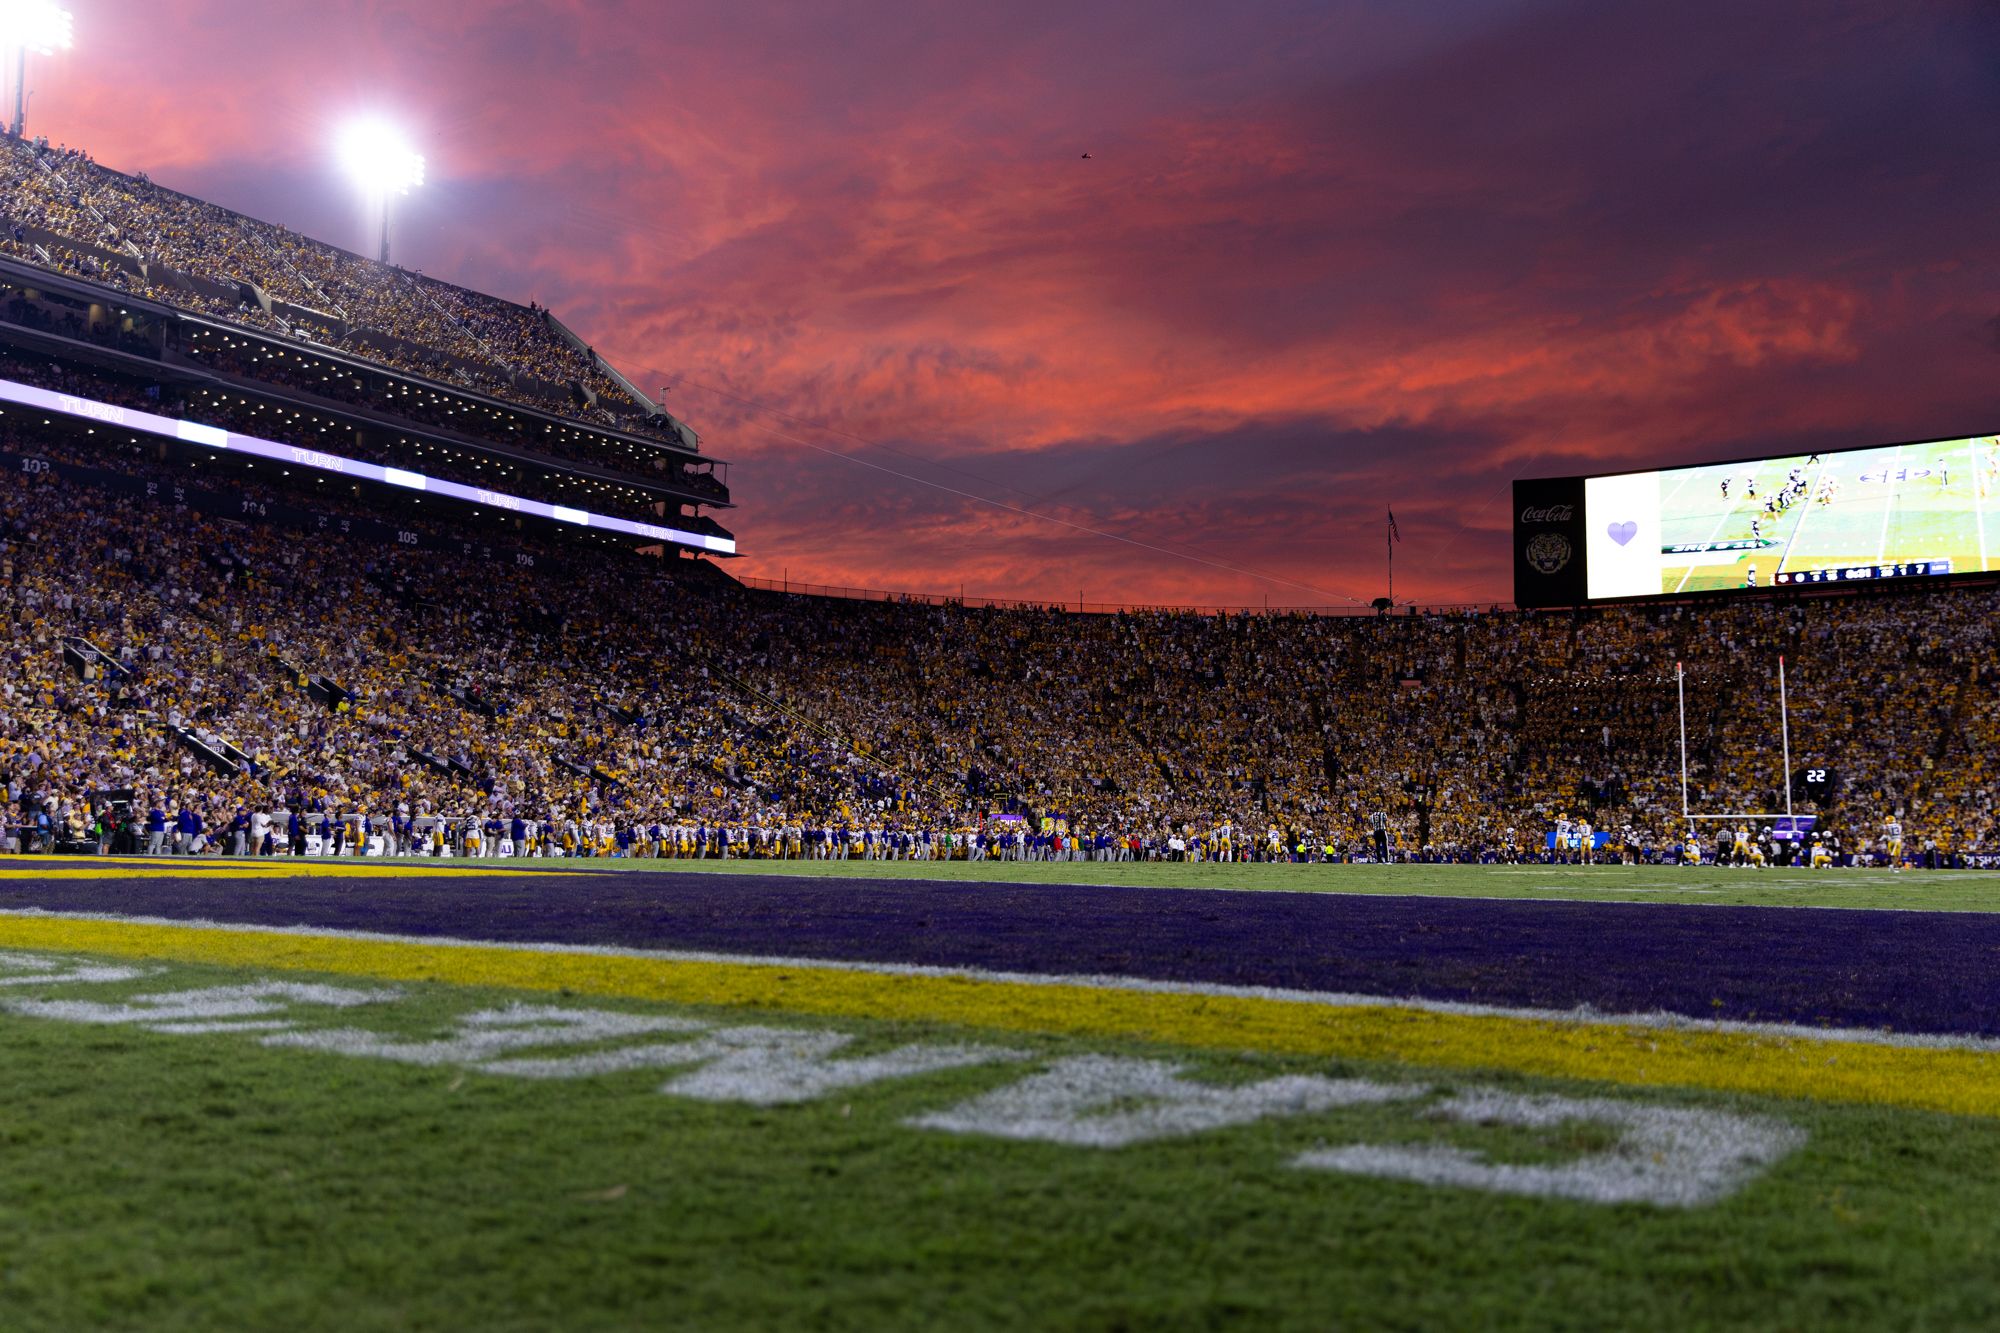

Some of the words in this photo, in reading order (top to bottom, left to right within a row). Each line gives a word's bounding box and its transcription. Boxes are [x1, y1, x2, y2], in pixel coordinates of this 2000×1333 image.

[58, 395, 125, 423] TURN
[291, 448, 344, 471] TURN
[477, 489, 520, 510] TURN
[1521, 504, 1575, 523] Coca-Cola
[397, 530, 418, 545] 105
[634, 522, 674, 541] TURN
[1806, 769, 1826, 783] 22
